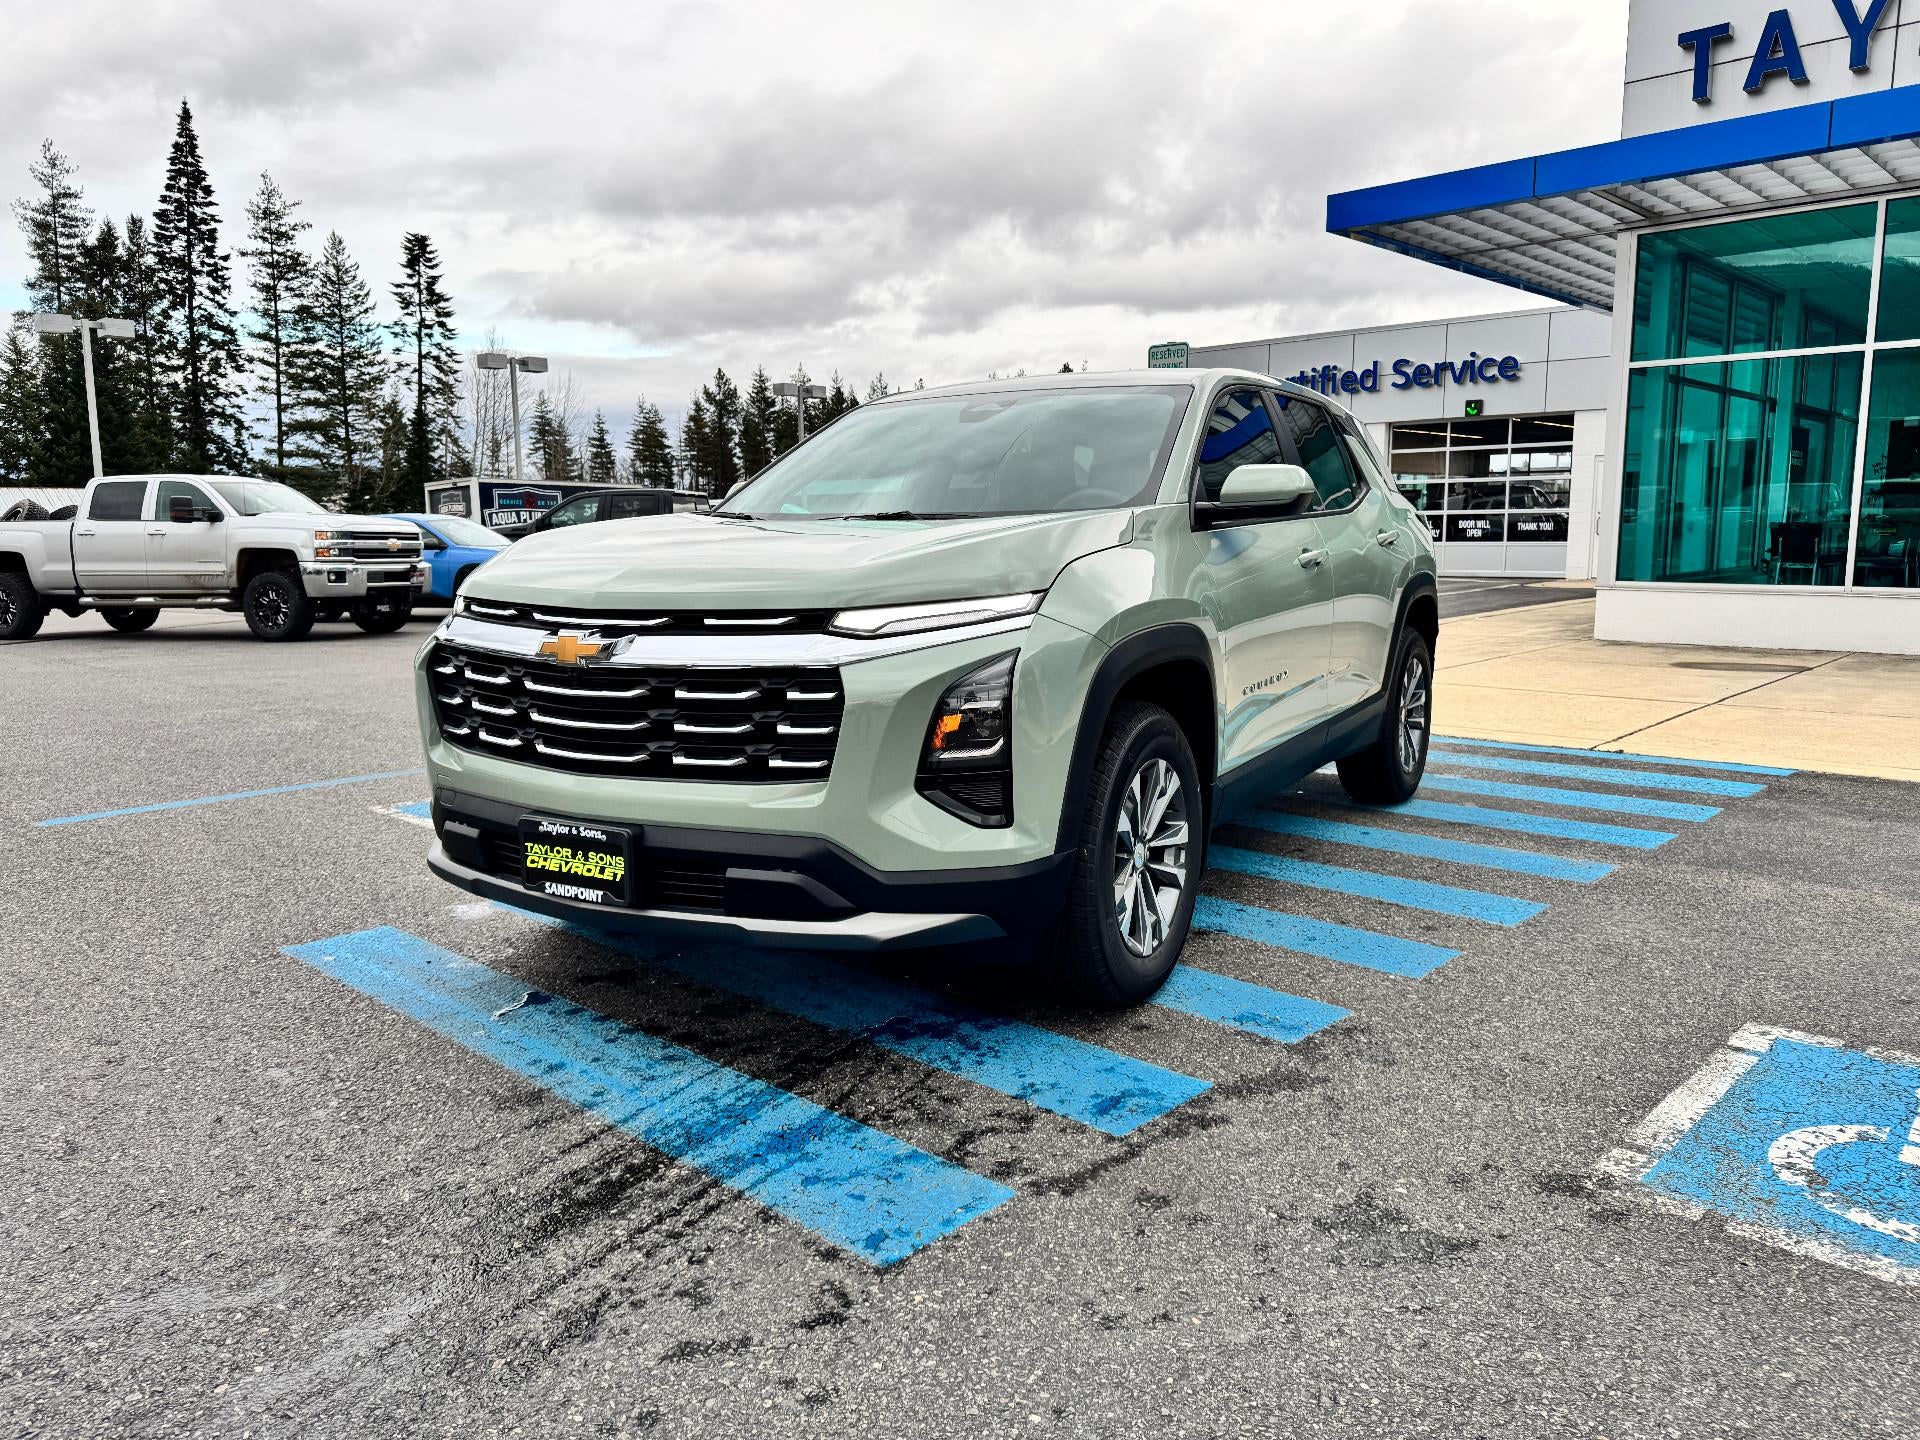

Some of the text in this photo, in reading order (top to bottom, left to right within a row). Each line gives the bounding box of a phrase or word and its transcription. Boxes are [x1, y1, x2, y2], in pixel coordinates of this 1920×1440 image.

[1151, 348, 1185, 361] RESERVED
[1391, 351, 1520, 390] Service
[492, 511, 519, 526] AQUA
[1458, 519, 1490, 529] DOOR WILL
[1517, 521, 1554, 531] THANK YOU!
[1466, 528, 1482, 538] OPEN
[541, 821, 602, 839] Taylor & Sons
[524, 842, 625, 868] TAYLOR & SONS
[526, 855, 625, 882] CHEVROLET
[544, 881, 604, 903] SANDPOINT
